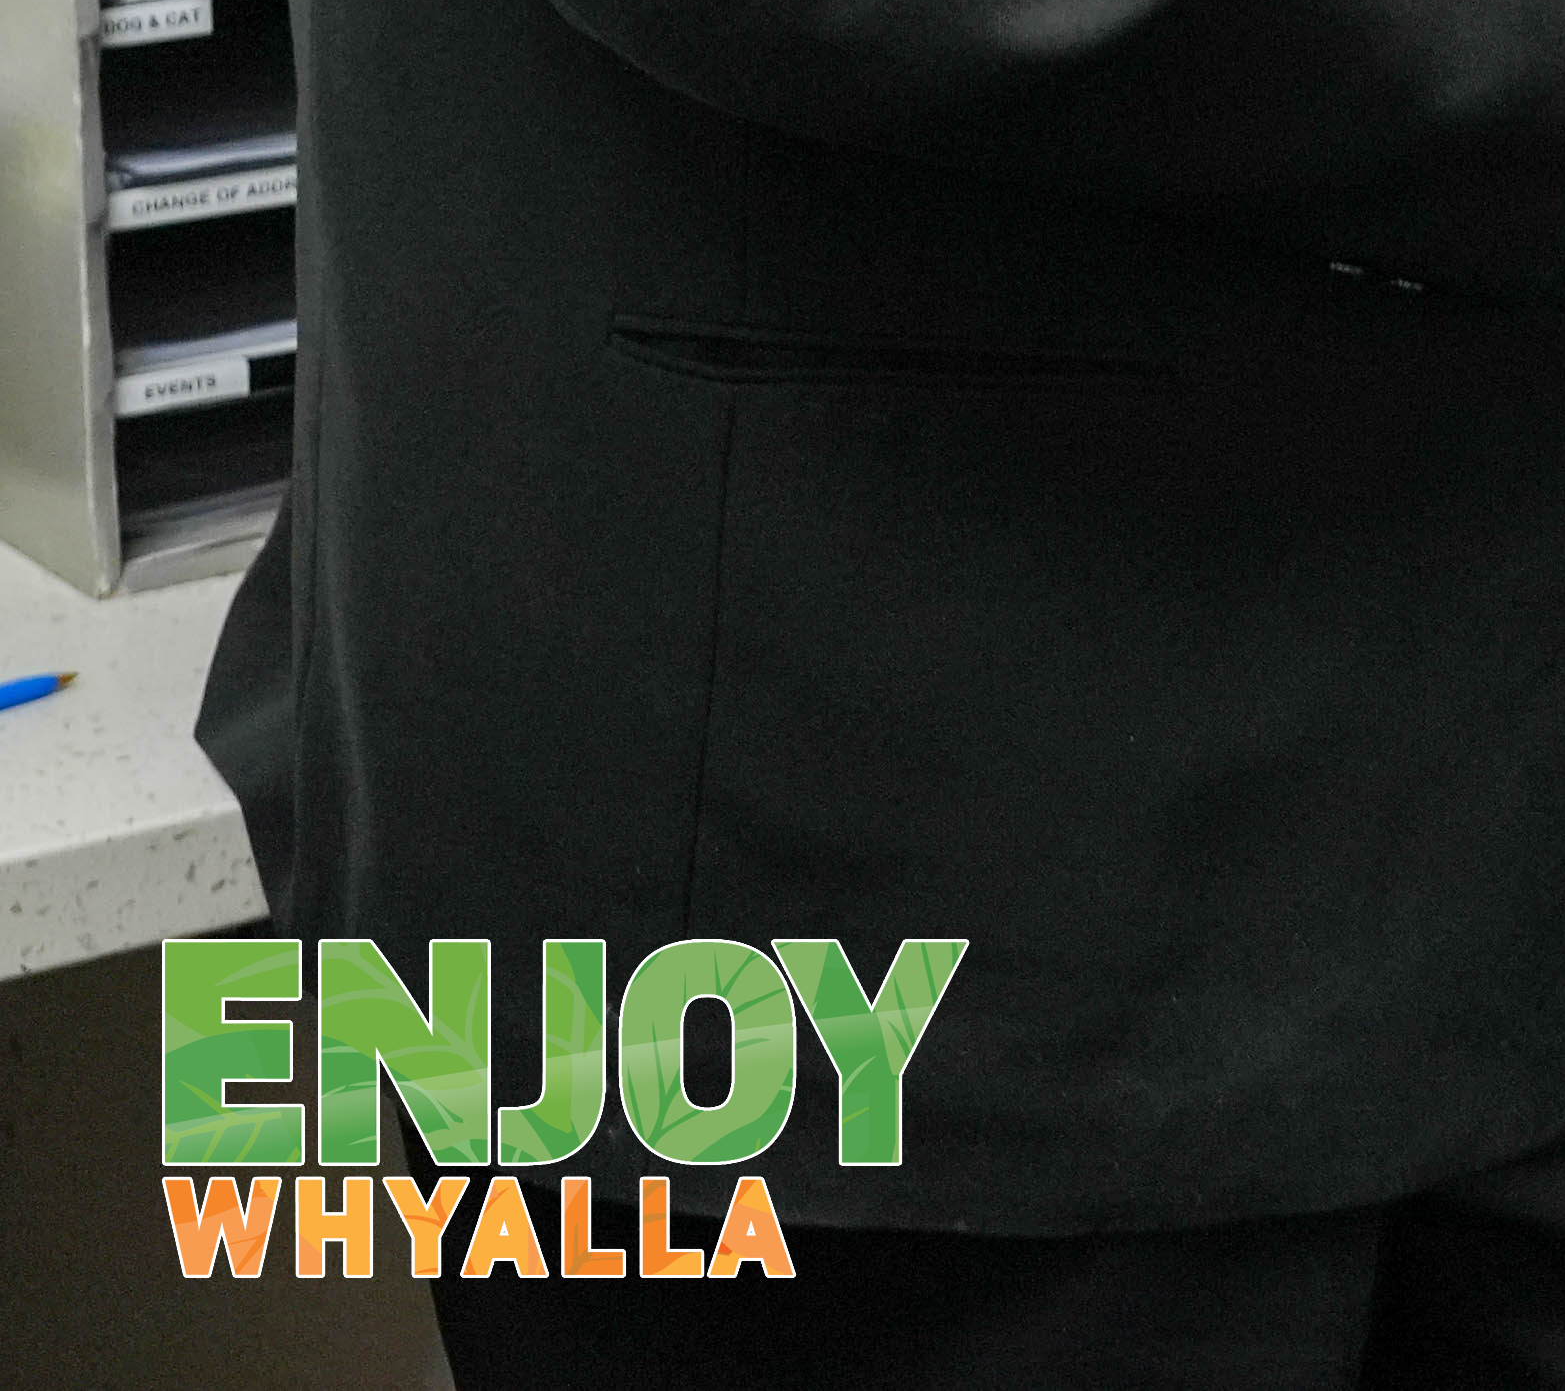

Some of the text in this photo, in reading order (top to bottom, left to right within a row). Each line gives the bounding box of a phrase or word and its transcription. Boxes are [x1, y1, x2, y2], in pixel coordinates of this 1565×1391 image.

[166, 7, 201, 25] CAT
[132, 189, 209, 216] CHANGE
[216, 185, 240, 201] OF
[144, 374, 216, 399] EVENTS
